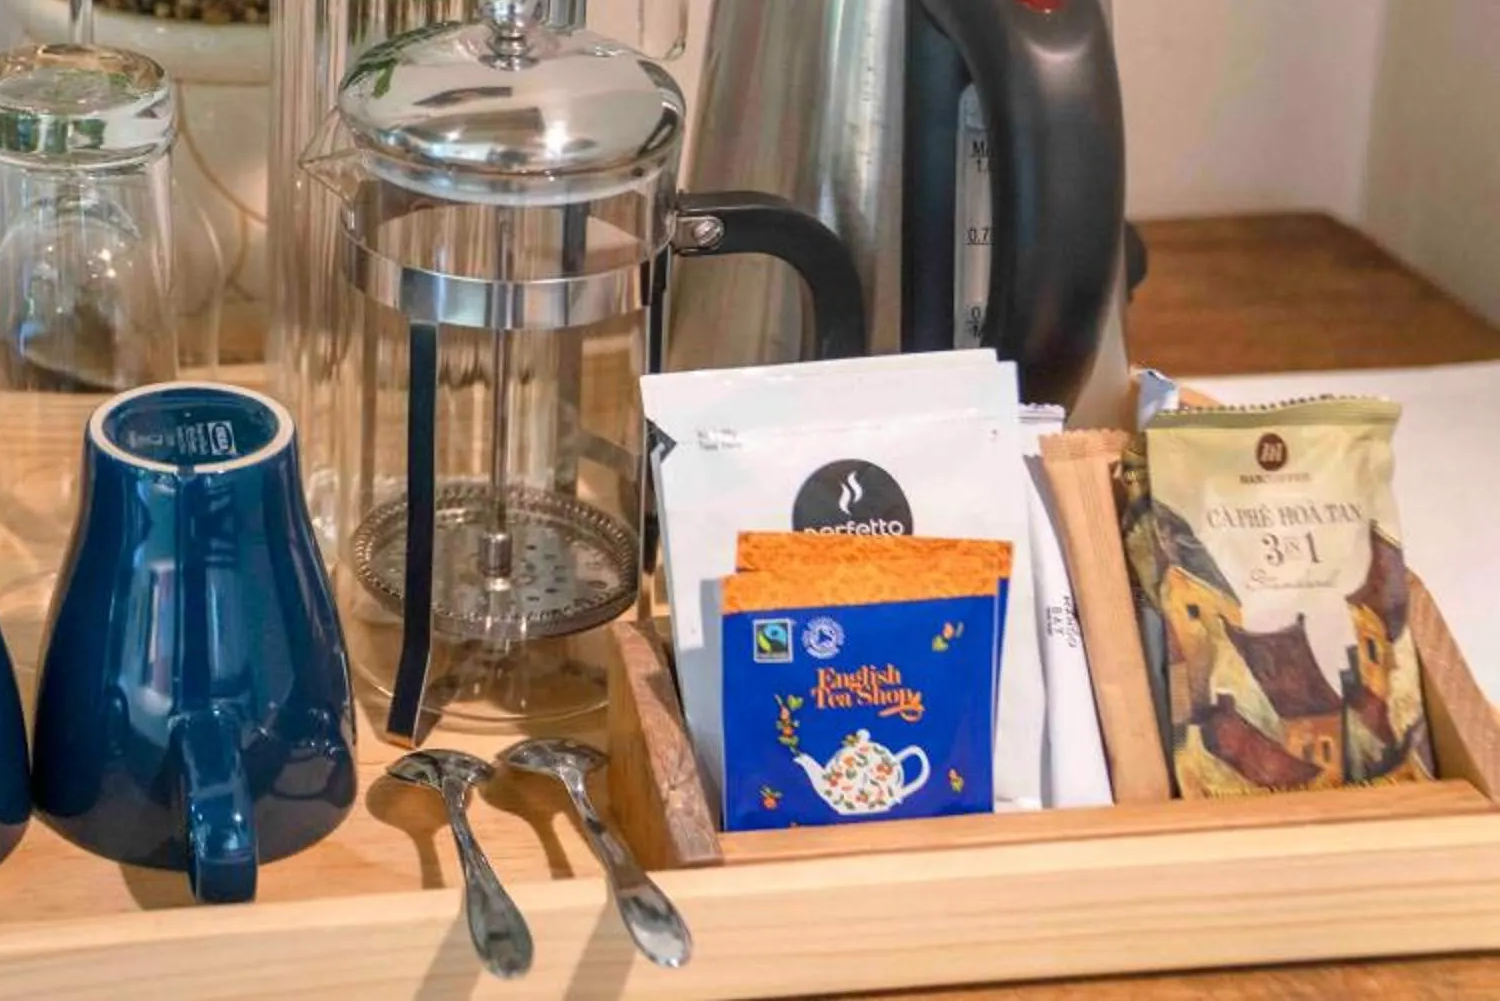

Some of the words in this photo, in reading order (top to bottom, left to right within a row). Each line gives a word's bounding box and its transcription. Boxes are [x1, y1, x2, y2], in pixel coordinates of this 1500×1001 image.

[817, 663, 901, 691] English
[810, 686, 853, 709] Tea
[857, 684, 925, 722] Shop
